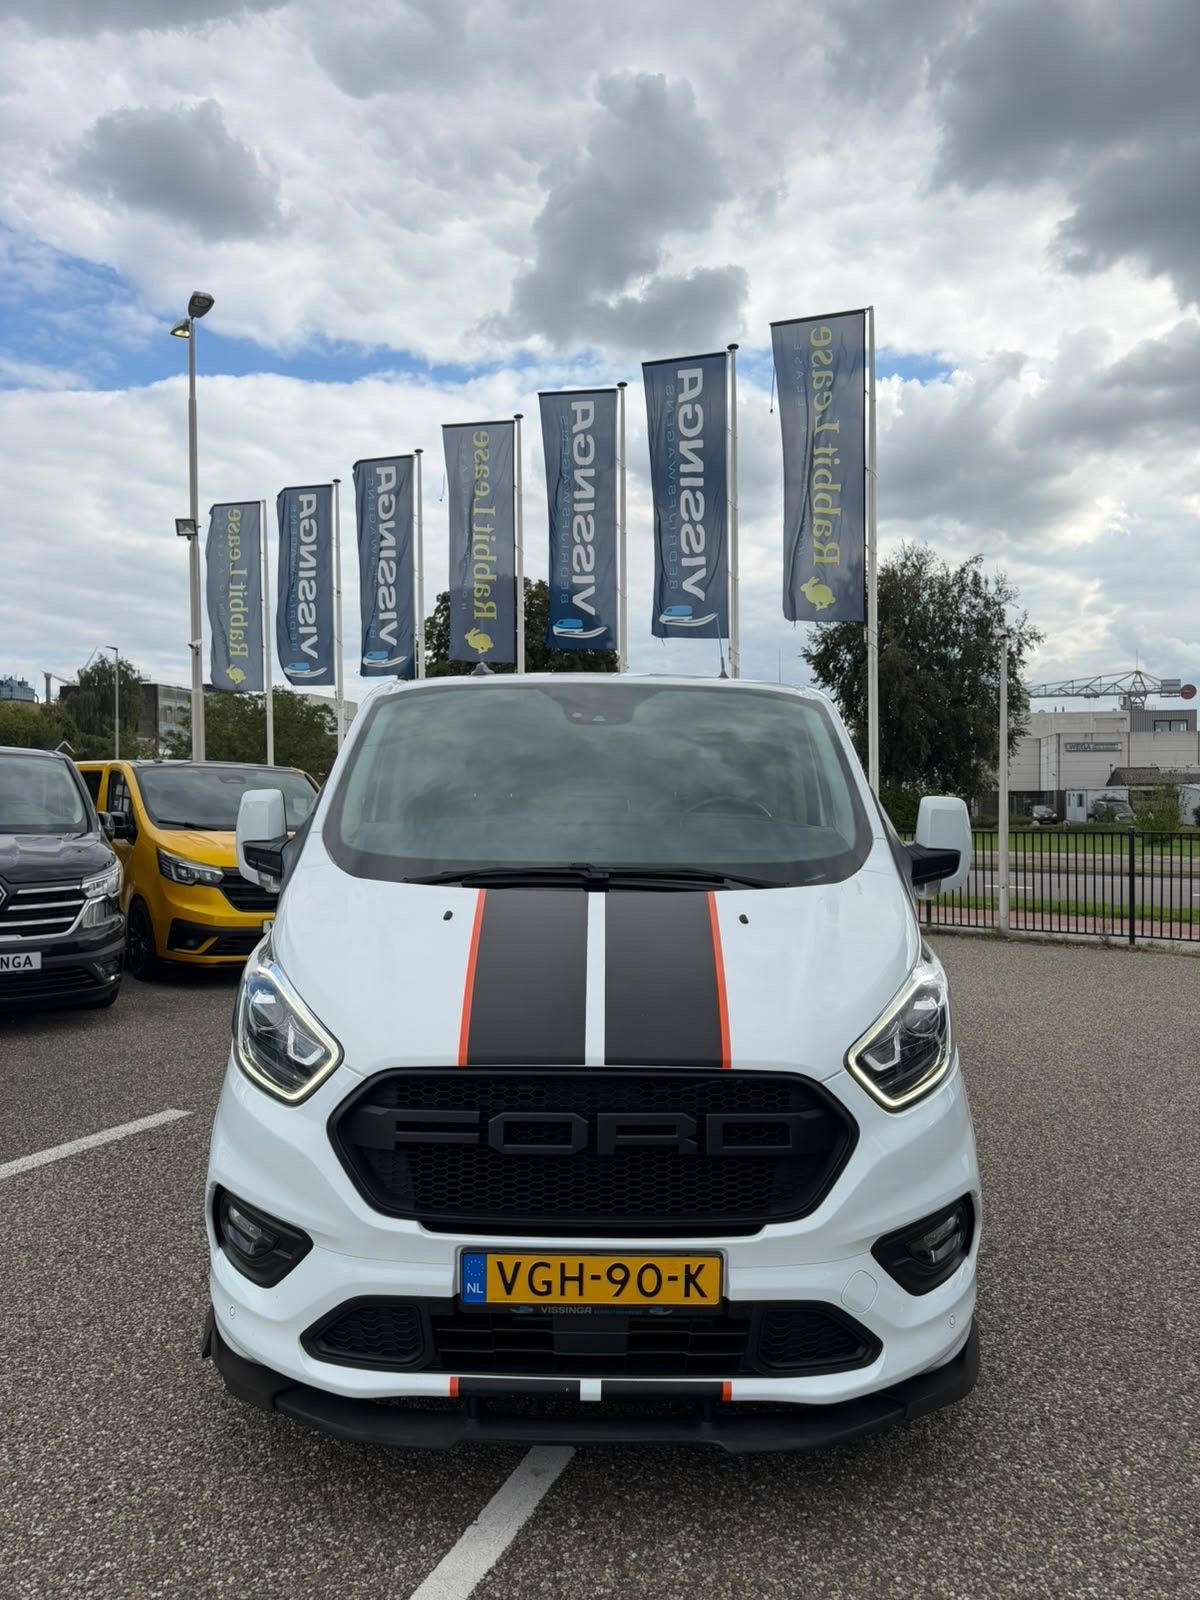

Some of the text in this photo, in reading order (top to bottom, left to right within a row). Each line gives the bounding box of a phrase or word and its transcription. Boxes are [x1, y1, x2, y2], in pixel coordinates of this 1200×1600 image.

[0, 955, 33, 969] NGA
[353, 1106, 824, 1156] FORD
[496, 1261, 708, 1298] VGH-90-K
[466, 1282, 484, 1294] NL
[540, 1306, 592, 1315] VISSINGA
